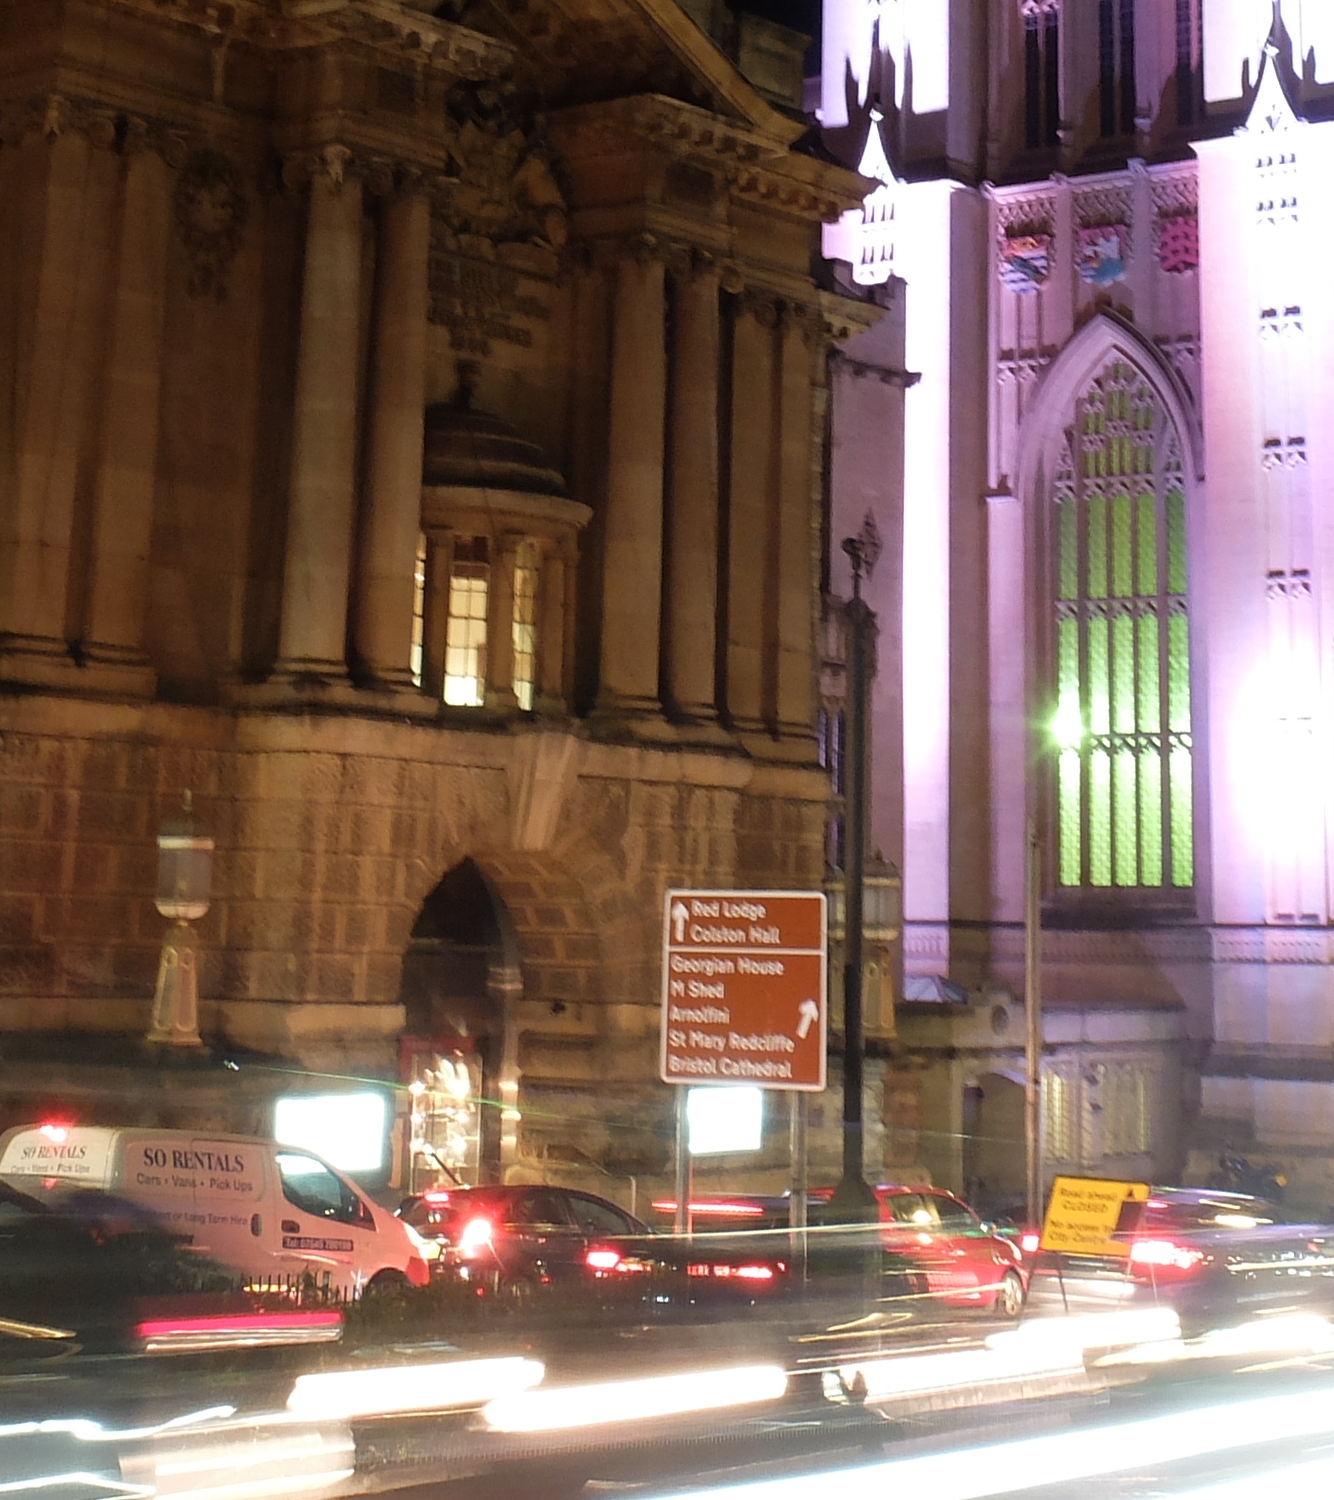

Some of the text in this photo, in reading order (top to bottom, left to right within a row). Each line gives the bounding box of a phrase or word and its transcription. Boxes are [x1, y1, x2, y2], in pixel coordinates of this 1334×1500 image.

[691, 900, 767, 921] Red Lodge
[690, 925, 781, 944] Colston Hall
[671, 956, 784, 977] Georgian House
[671, 980, 725, 999] M Shed
[669, 1006, 730, 1024] Arnolfini
[669, 1030, 795, 1052] St Mary Redcliffe
[668, 1055, 792, 1078] Bristol Cathedral
[21, 1145, 86, 1160] SO RENTALS
[144, 1147, 244, 1173] SO RENTALS
[137, 1172, 253, 1193] Cars Vans Pick Ups
